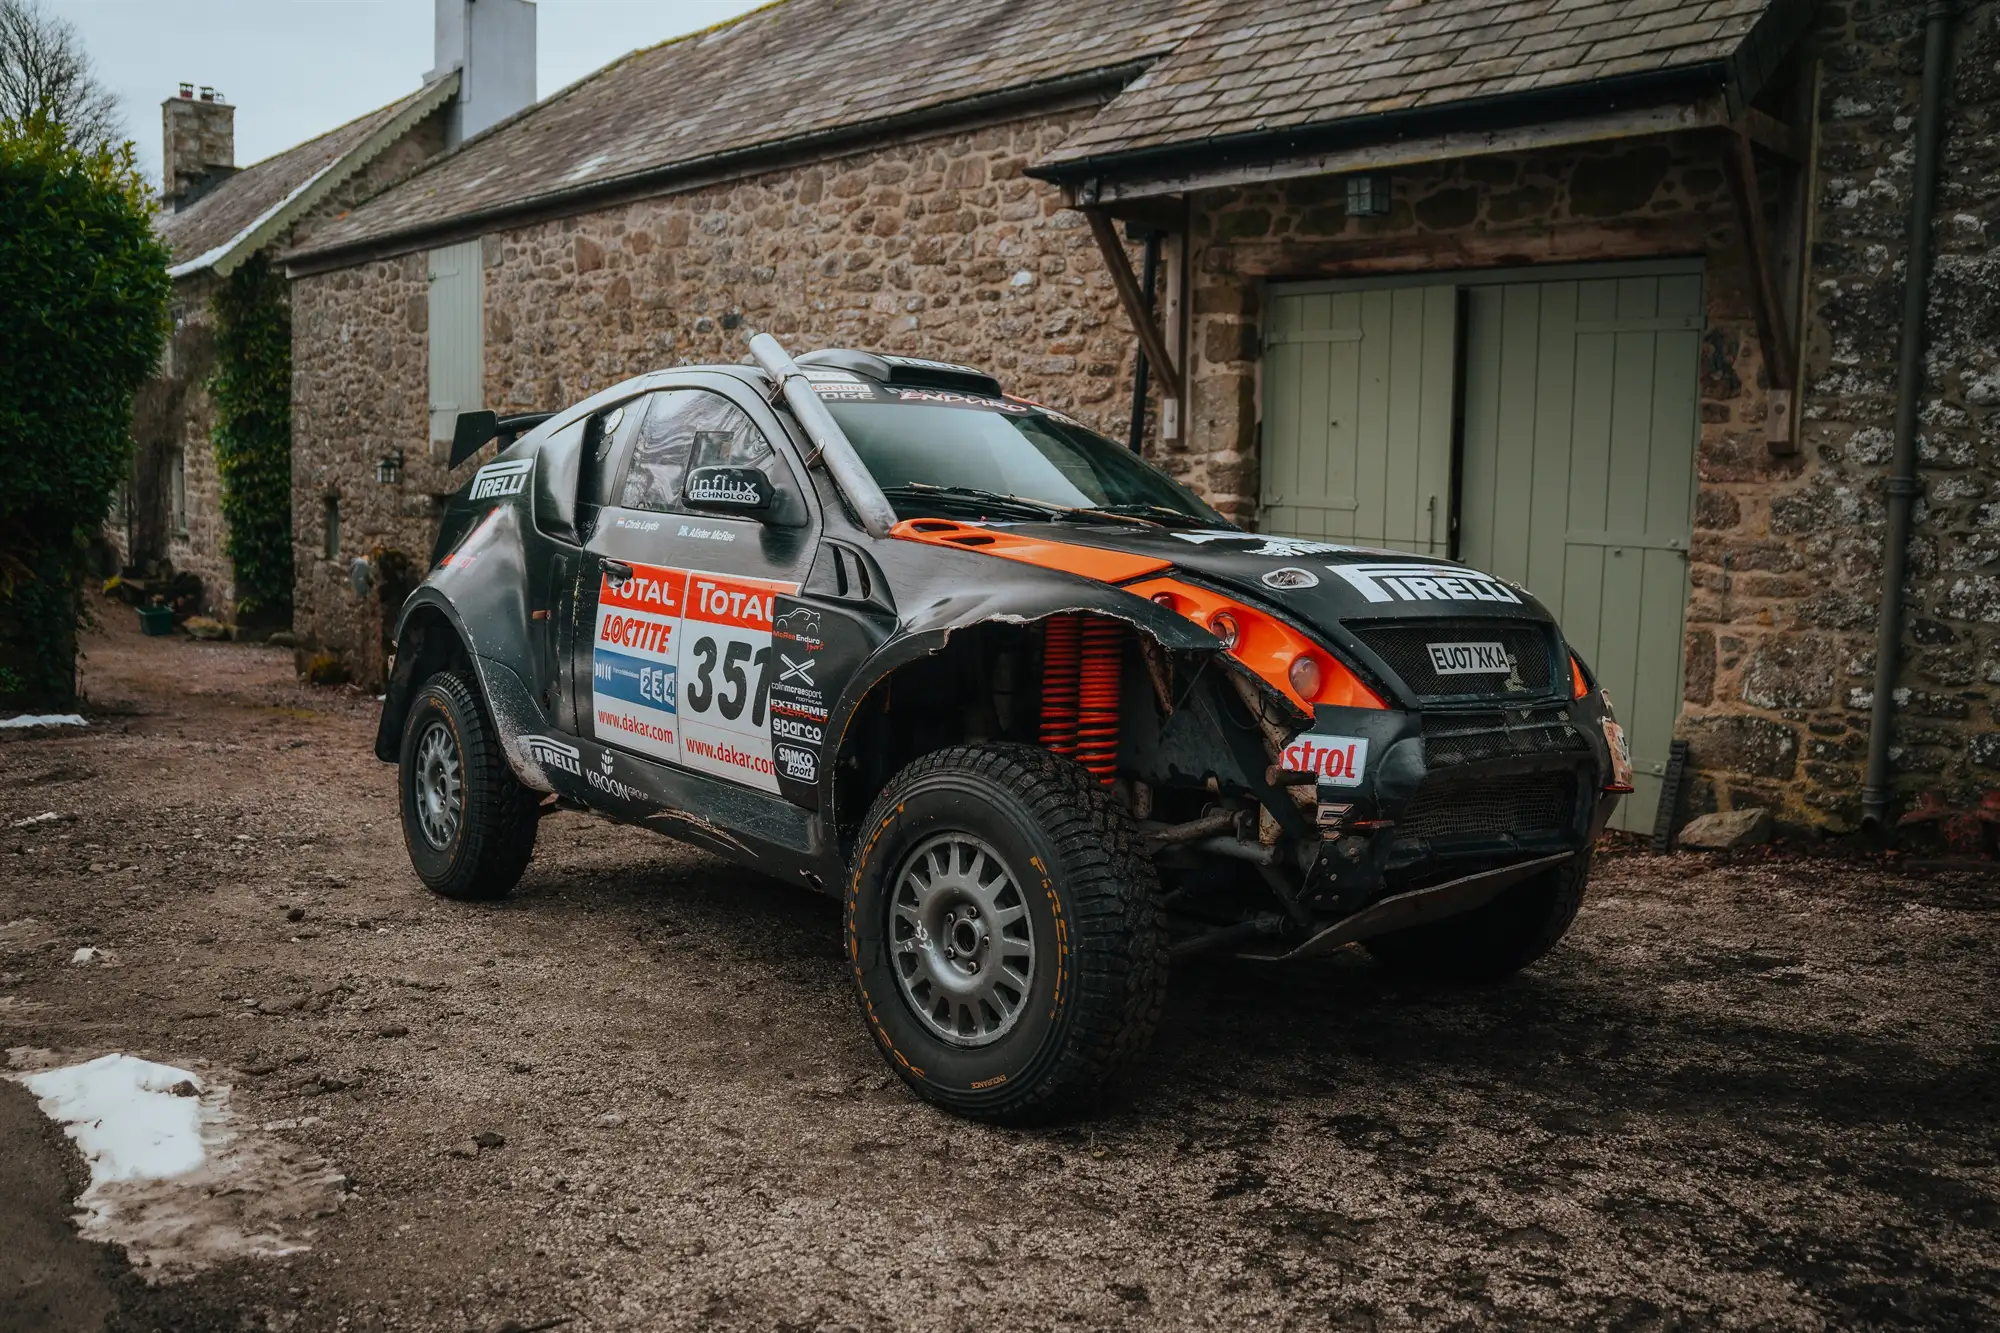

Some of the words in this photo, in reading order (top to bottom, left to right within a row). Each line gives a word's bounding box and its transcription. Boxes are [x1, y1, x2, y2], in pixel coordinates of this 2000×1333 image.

[820, 392, 876, 400] DGE
[469, 458, 534, 500] PIRELLI
[692, 474, 757, 493] influx
[690, 491, 759, 502] TECHNOLOGY
[625, 519, 641, 530] Chris
[688, 527, 711, 539] Alister
[710, 529, 735, 541] McRae
[1325, 563, 1523, 604] PIRELLI
[601, 613, 673, 654] LOCTITE
[1431, 647, 1473, 669] EU07
[1473, 646, 1508, 668] XKA
[643, 675, 652, 694] 2
[655, 678, 663, 697] 3
[666, 681, 675, 701] 4
[686, 636, 772, 728] 351
[771, 698, 828, 717] EXTREME
[598, 709, 674, 745] www.dakar.com
[773, 718, 822, 740] sparco
[518, 735, 582, 777] PIRELLI
[1279, 741, 1356, 778] strol
[586, 769, 631, 801] KROON
[628, 786, 649, 801] GROUP
